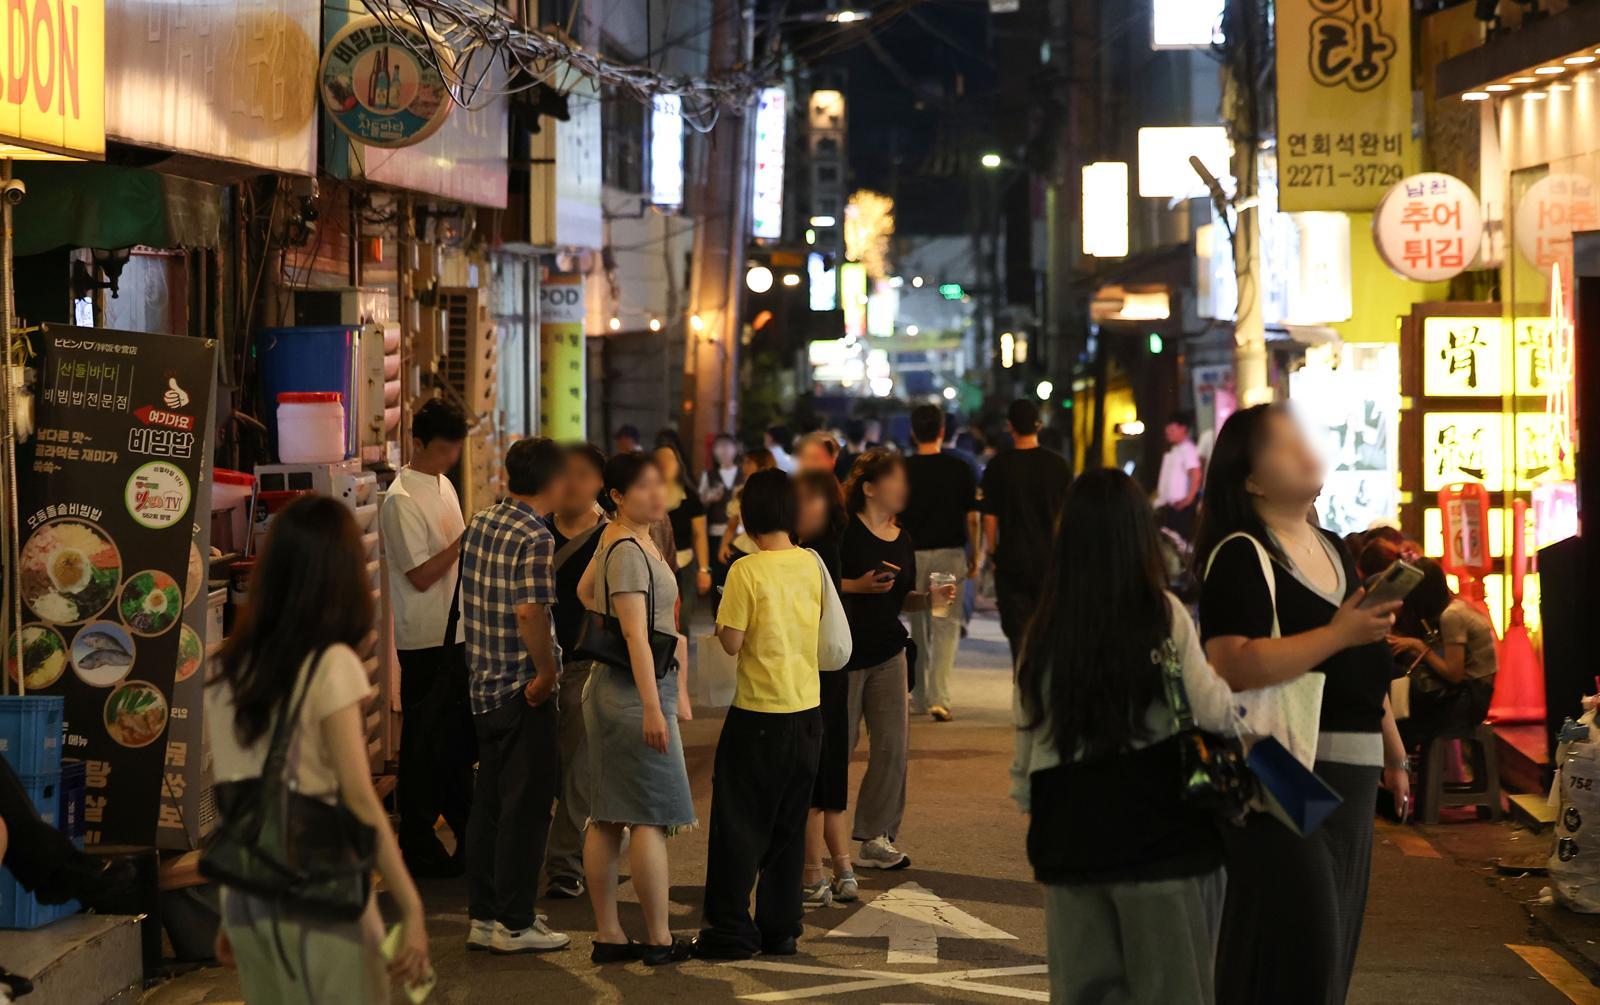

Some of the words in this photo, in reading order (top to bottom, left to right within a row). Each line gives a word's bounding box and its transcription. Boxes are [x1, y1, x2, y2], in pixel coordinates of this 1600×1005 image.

[0, 0, 80, 119] DON
[1286, 164, 1404, 188] 2271-3729
[1405, 178, 1448, 198] 남원
[1400, 200, 1462, 231] 추어
[1402, 236, 1465, 270] 튀김
[44, 387, 128, 411] 비빔밥전문점
[148, 409, 190, 430] 여기가요
[128, 427, 195, 459] 비빔밥
[81, 448, 119, 464] 재미가
